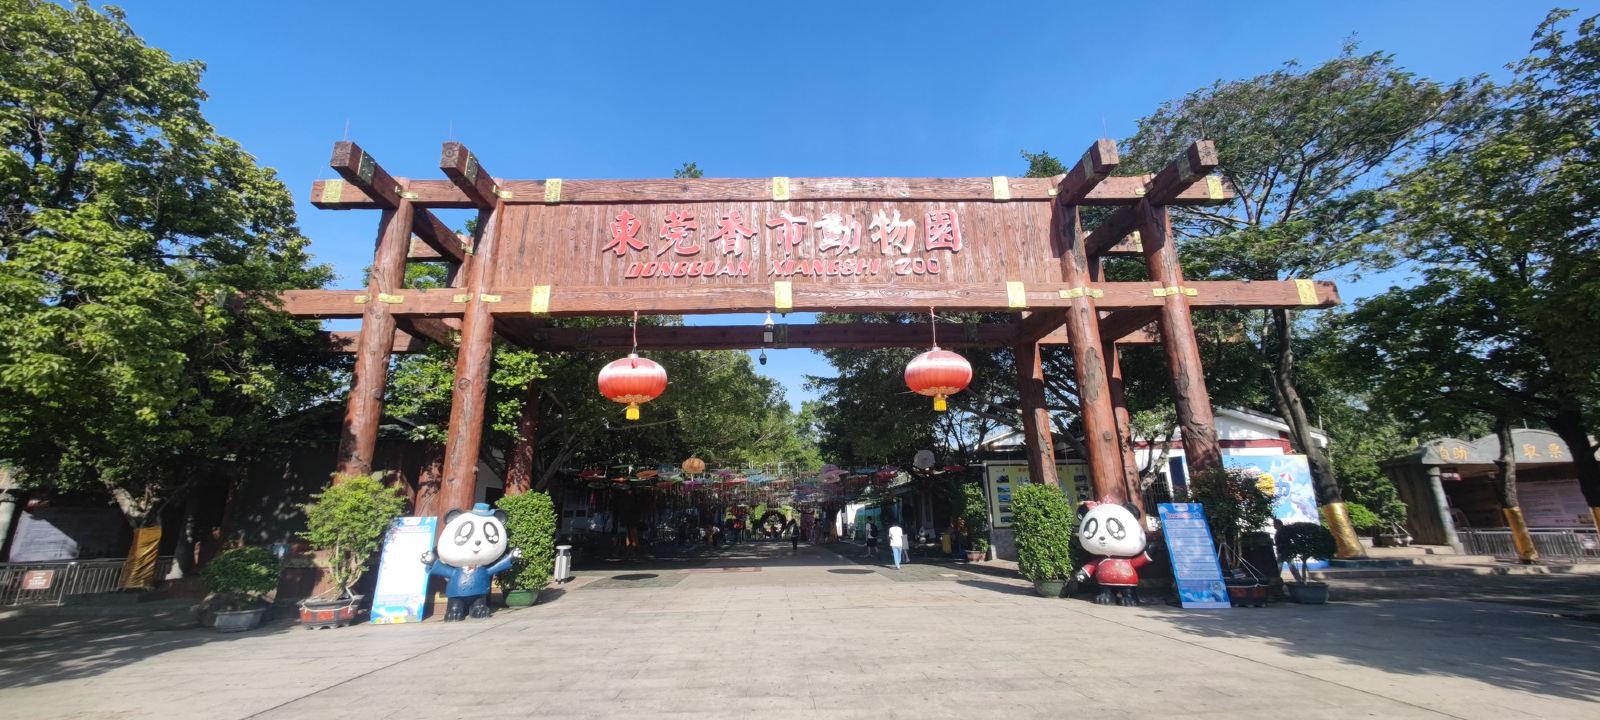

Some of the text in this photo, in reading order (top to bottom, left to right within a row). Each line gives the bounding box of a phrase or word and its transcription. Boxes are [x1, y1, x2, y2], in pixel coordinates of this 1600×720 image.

[601, 209, 965, 257] 東莞香市動物園
[624, 257, 941, 279] DONGGUAN XIANGSHI ZOO
